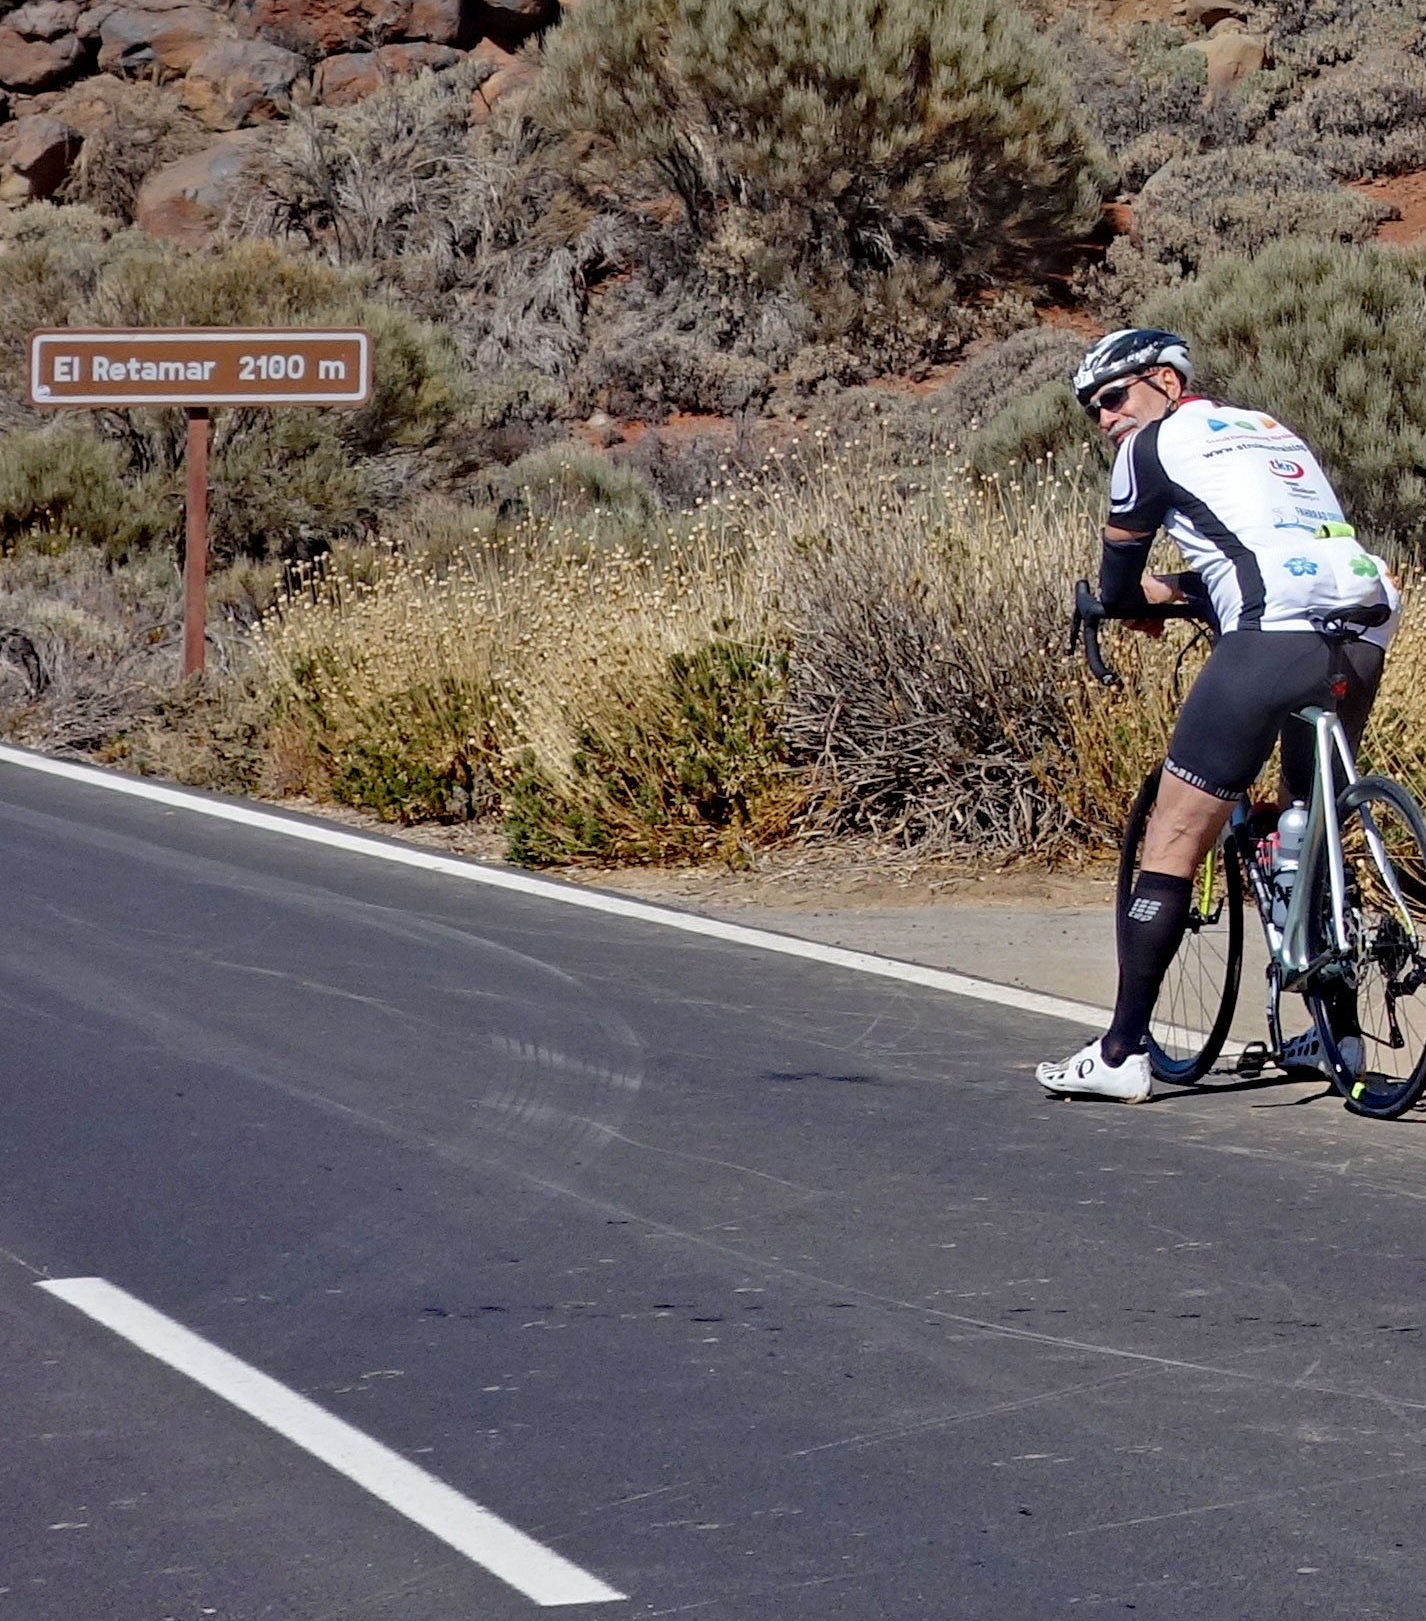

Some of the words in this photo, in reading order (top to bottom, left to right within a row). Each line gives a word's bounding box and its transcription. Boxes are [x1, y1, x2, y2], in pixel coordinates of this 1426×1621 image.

[53, 356, 80, 382] El
[92, 356, 216, 382] Retamar
[238, 354, 305, 381] 2100
[318, 359, 345, 380] m
